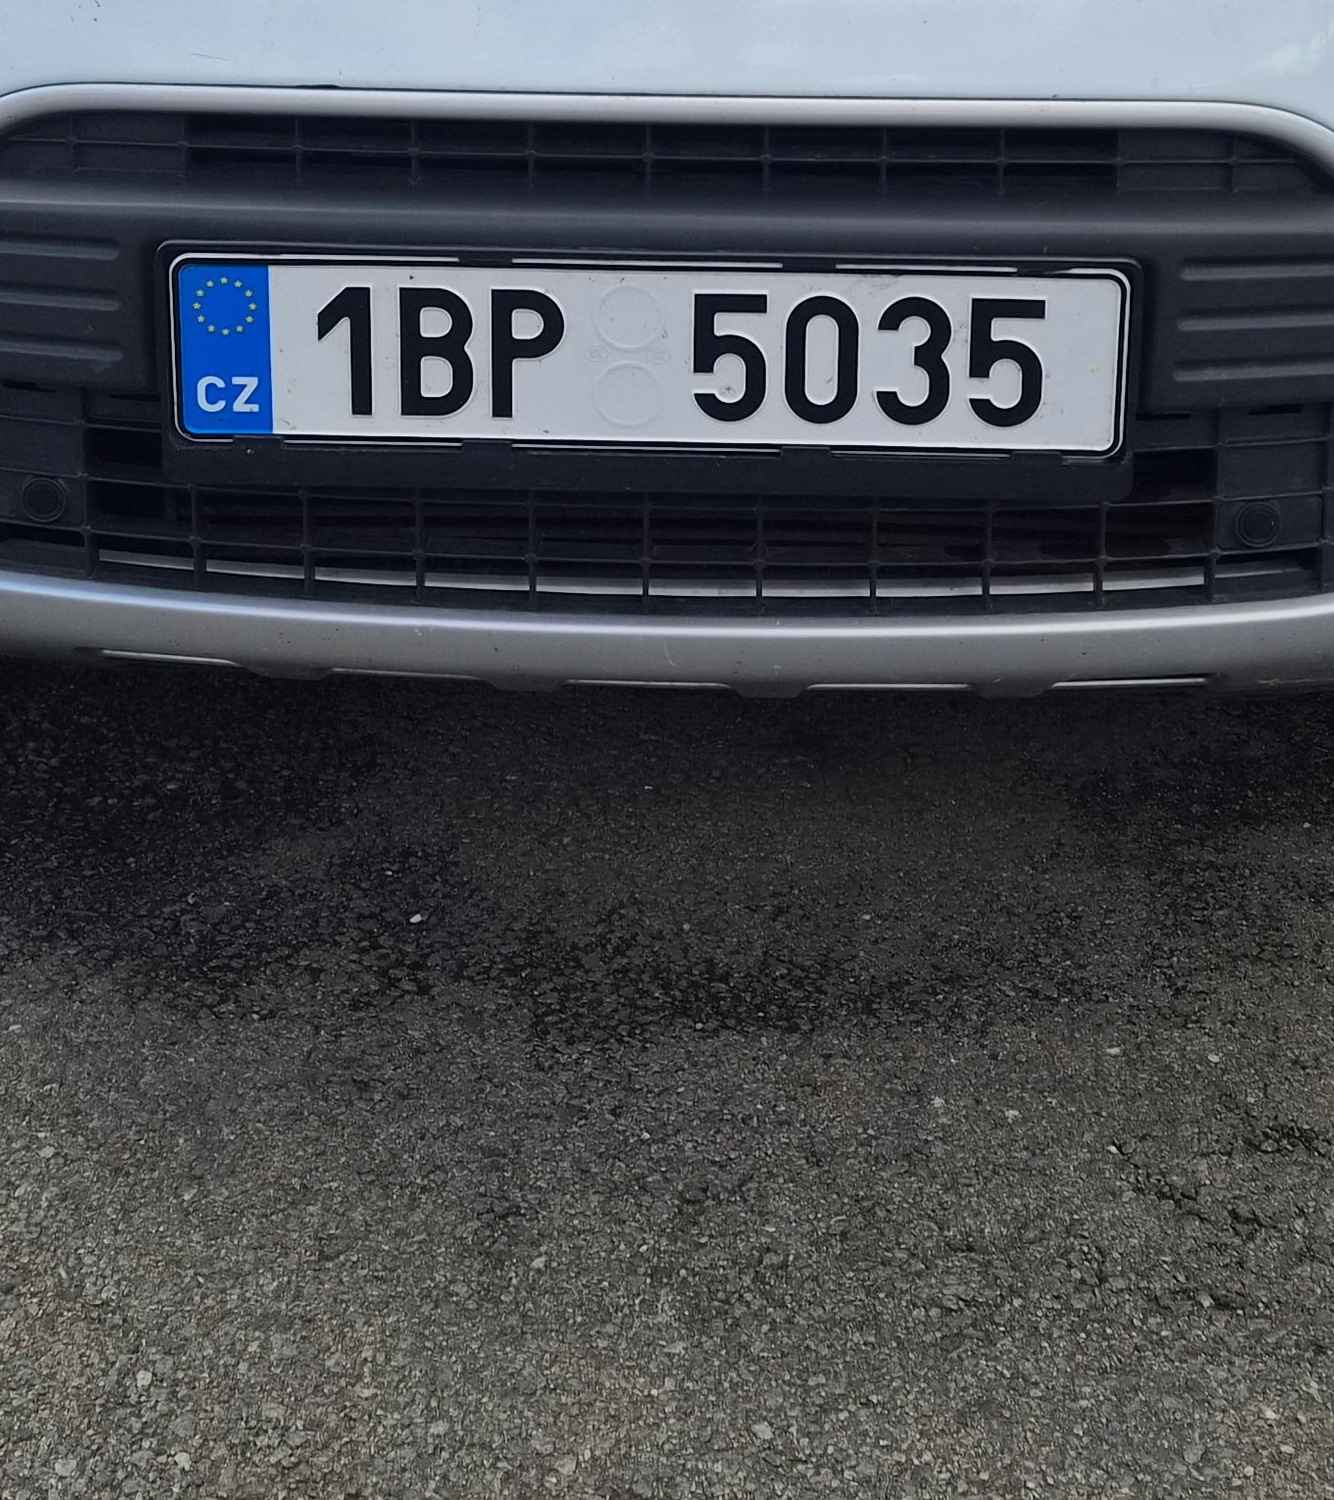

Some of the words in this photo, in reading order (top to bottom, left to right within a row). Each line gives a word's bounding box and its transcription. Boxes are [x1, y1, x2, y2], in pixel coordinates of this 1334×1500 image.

[196, 376, 259, 413] CZ
[317, 286, 565, 419] 1BP
[693, 293, 1046, 428] 5035
